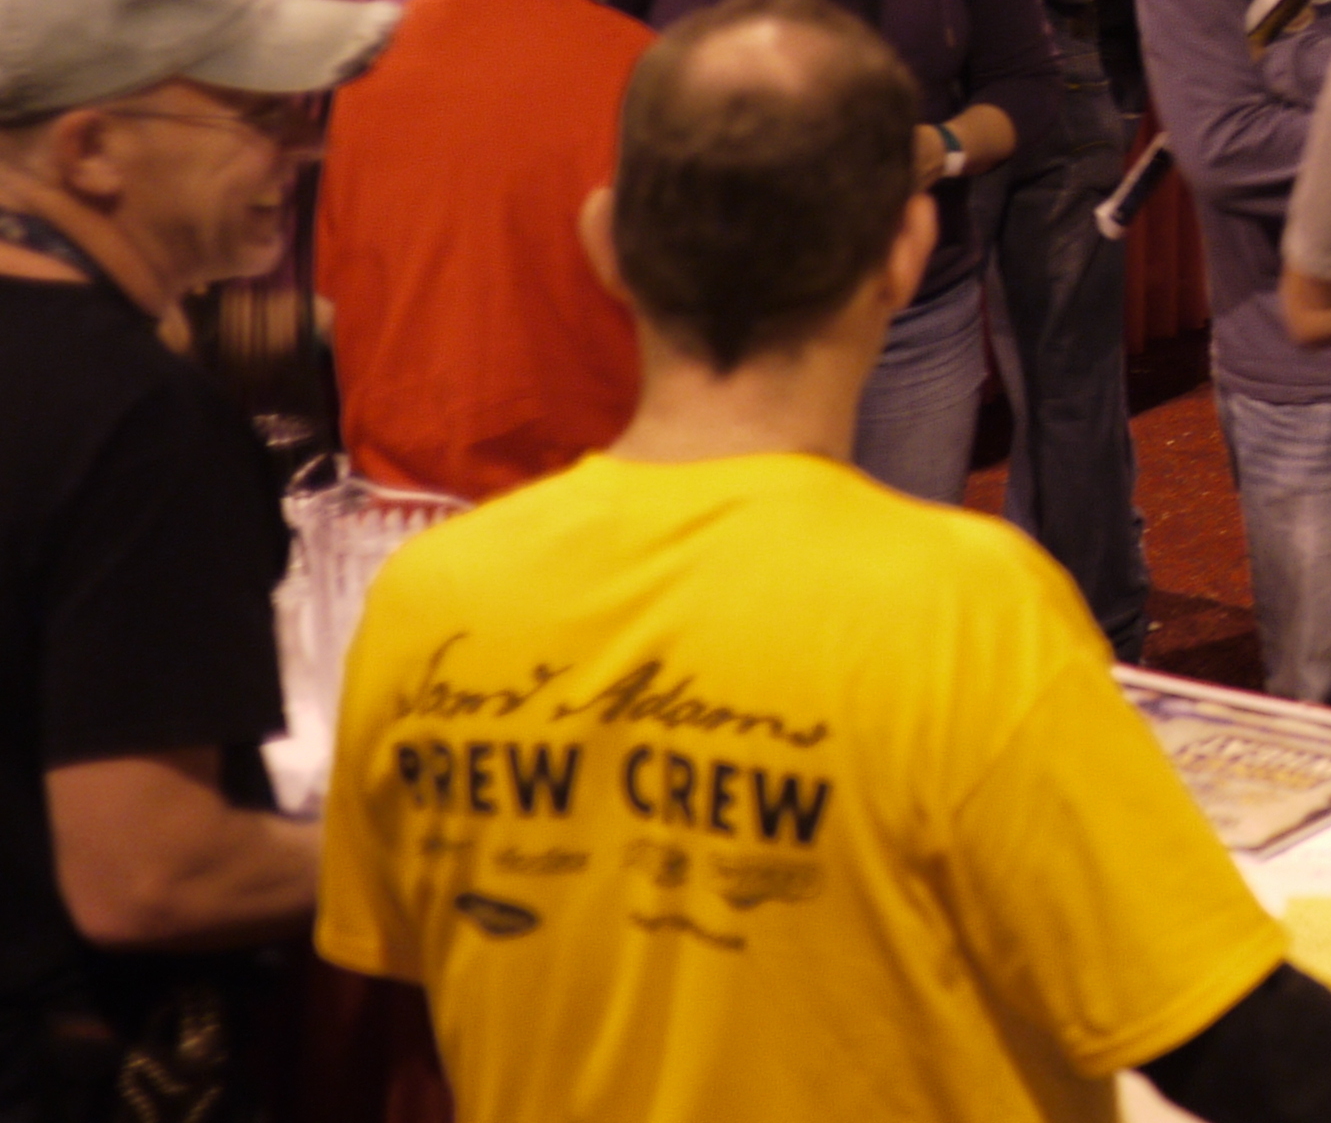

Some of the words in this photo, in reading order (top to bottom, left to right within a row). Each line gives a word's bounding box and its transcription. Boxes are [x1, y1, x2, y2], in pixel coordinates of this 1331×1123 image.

[552, 659, 830, 748] Adams
[395, 740, 584, 819] BREW
[622, 740, 832, 844] CREW
